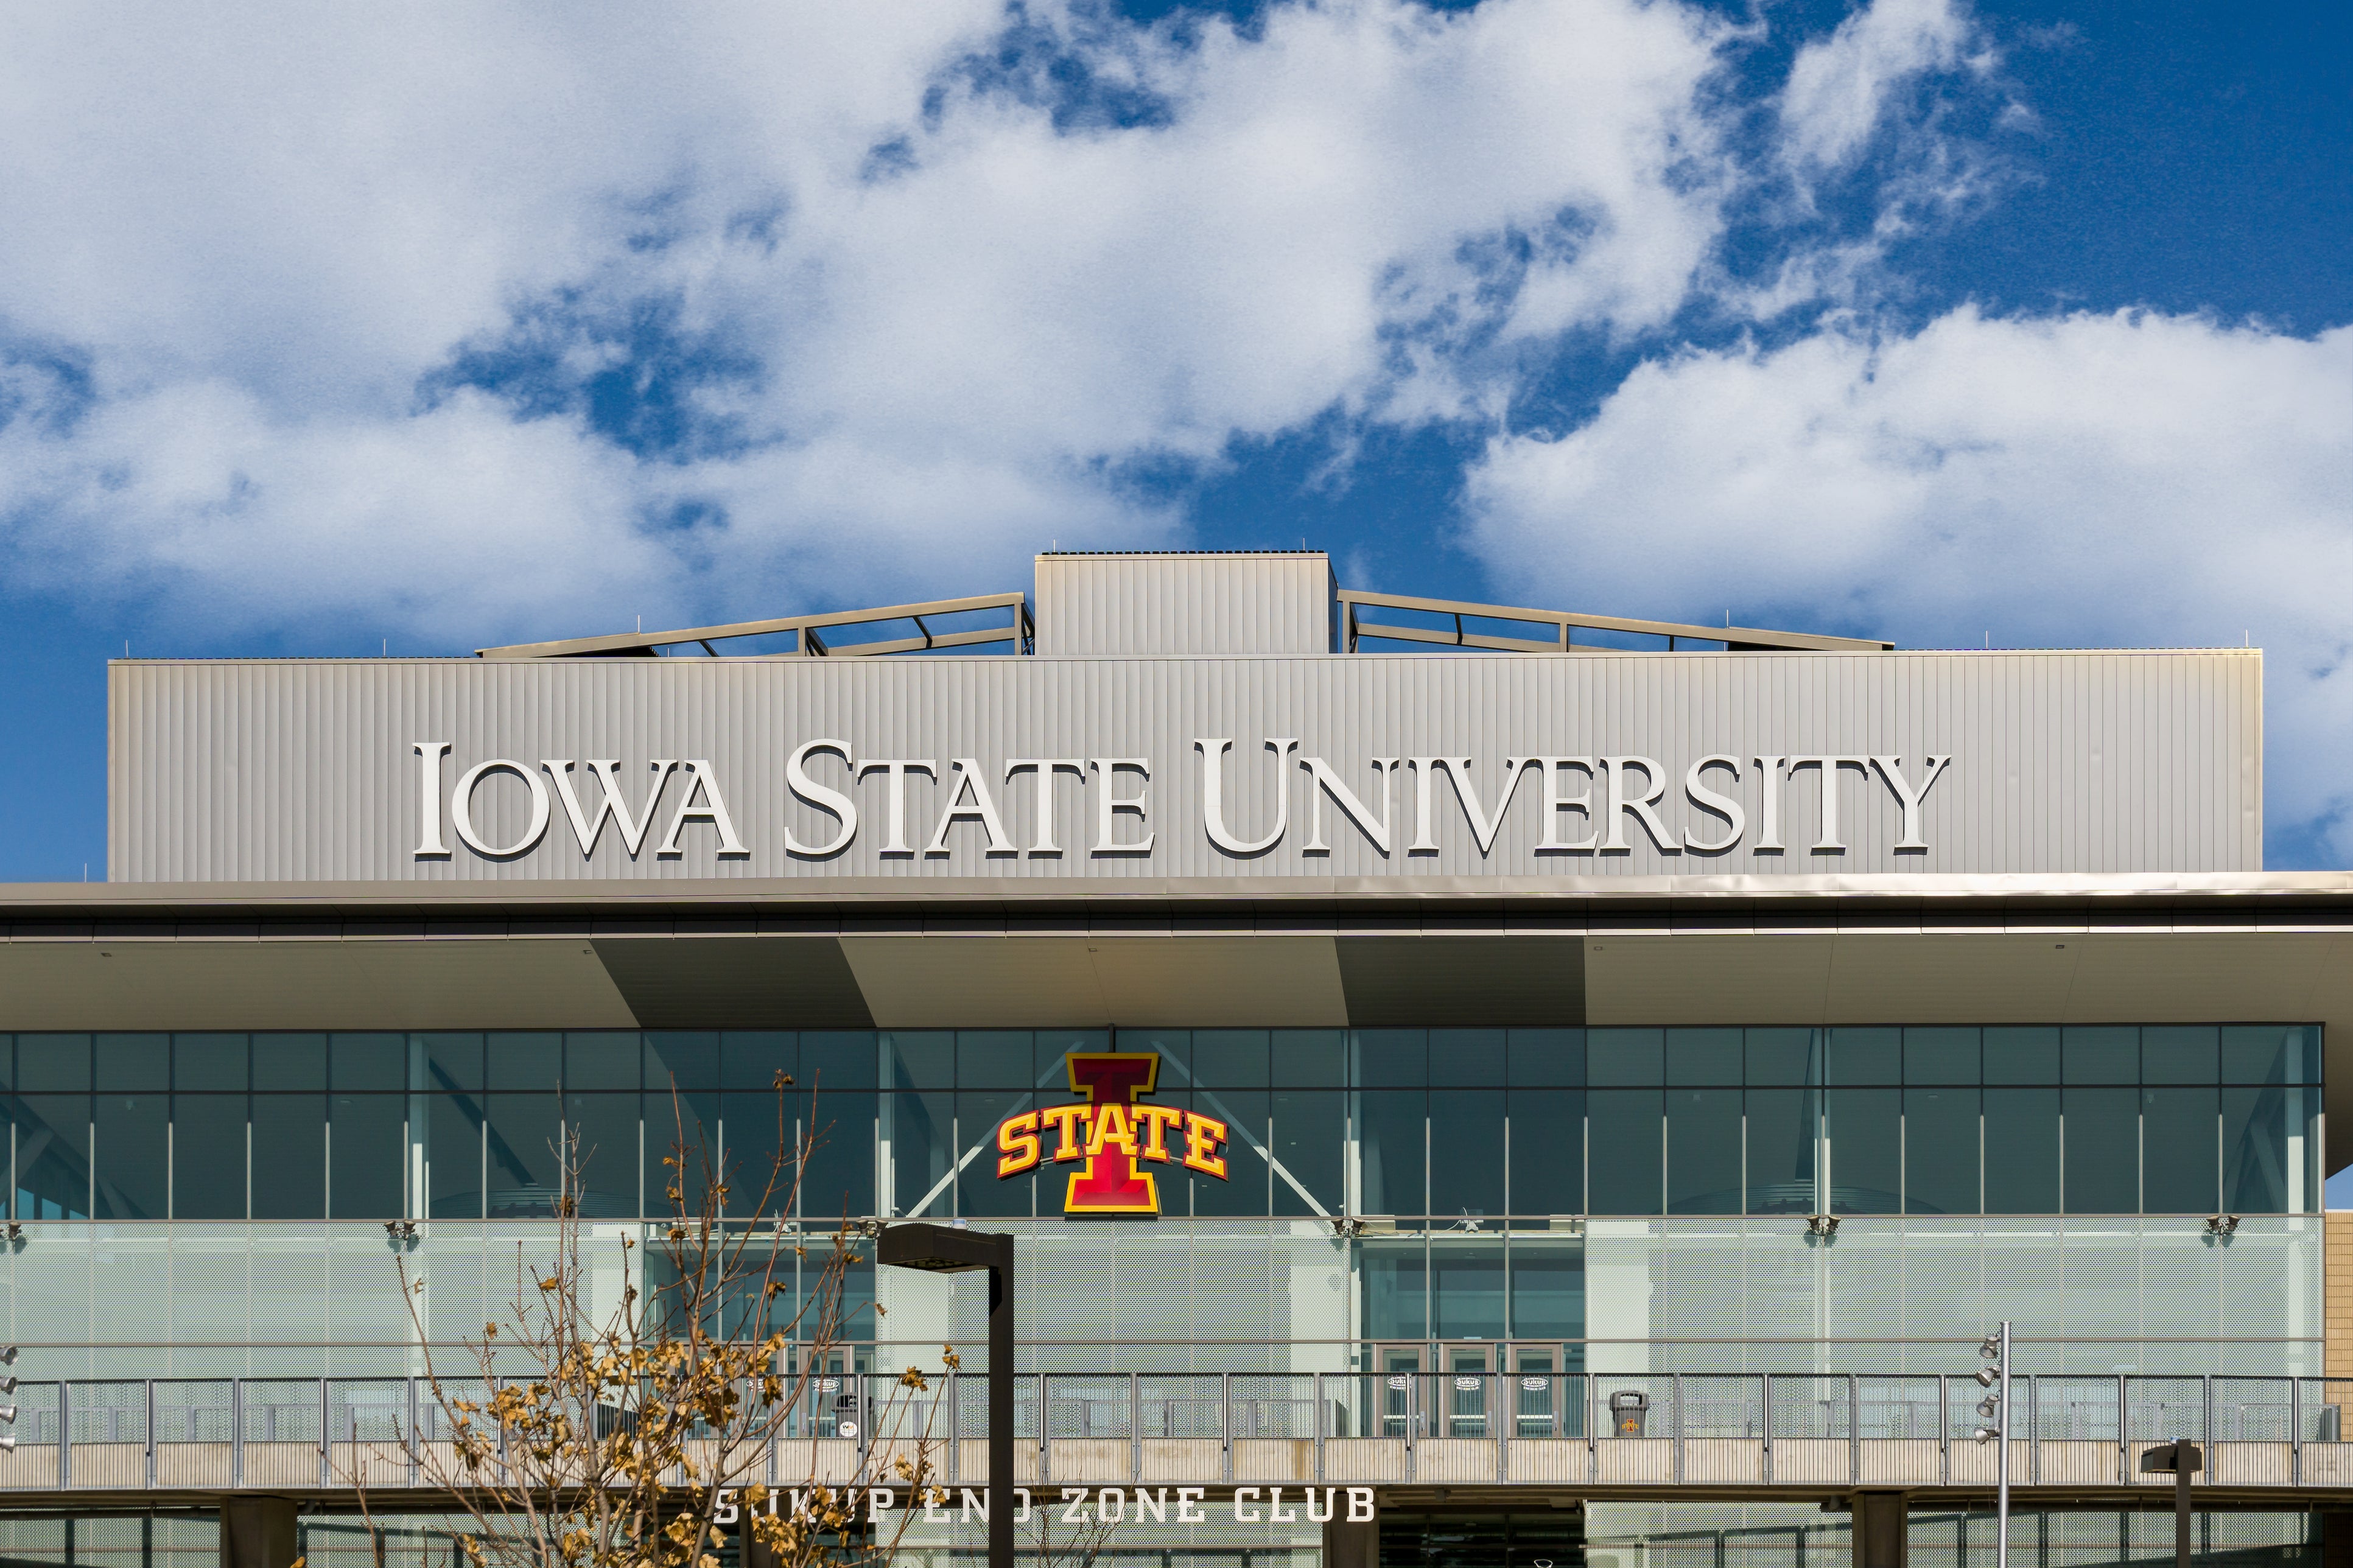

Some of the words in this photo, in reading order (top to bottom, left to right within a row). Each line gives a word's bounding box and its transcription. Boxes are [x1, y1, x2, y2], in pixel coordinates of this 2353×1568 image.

[412, 741, 750, 855] IOWA
[784, 738, 1155, 855] STATE
[1193, 738, 1952, 855] UNIVERSITY
[997, 1101, 1228, 1181] STATE
[1457, 1377, 1479, 1386] Sukup
[1062, 1487, 1205, 1522] ZONE
[1234, 1486, 1375, 1522] CLUB
